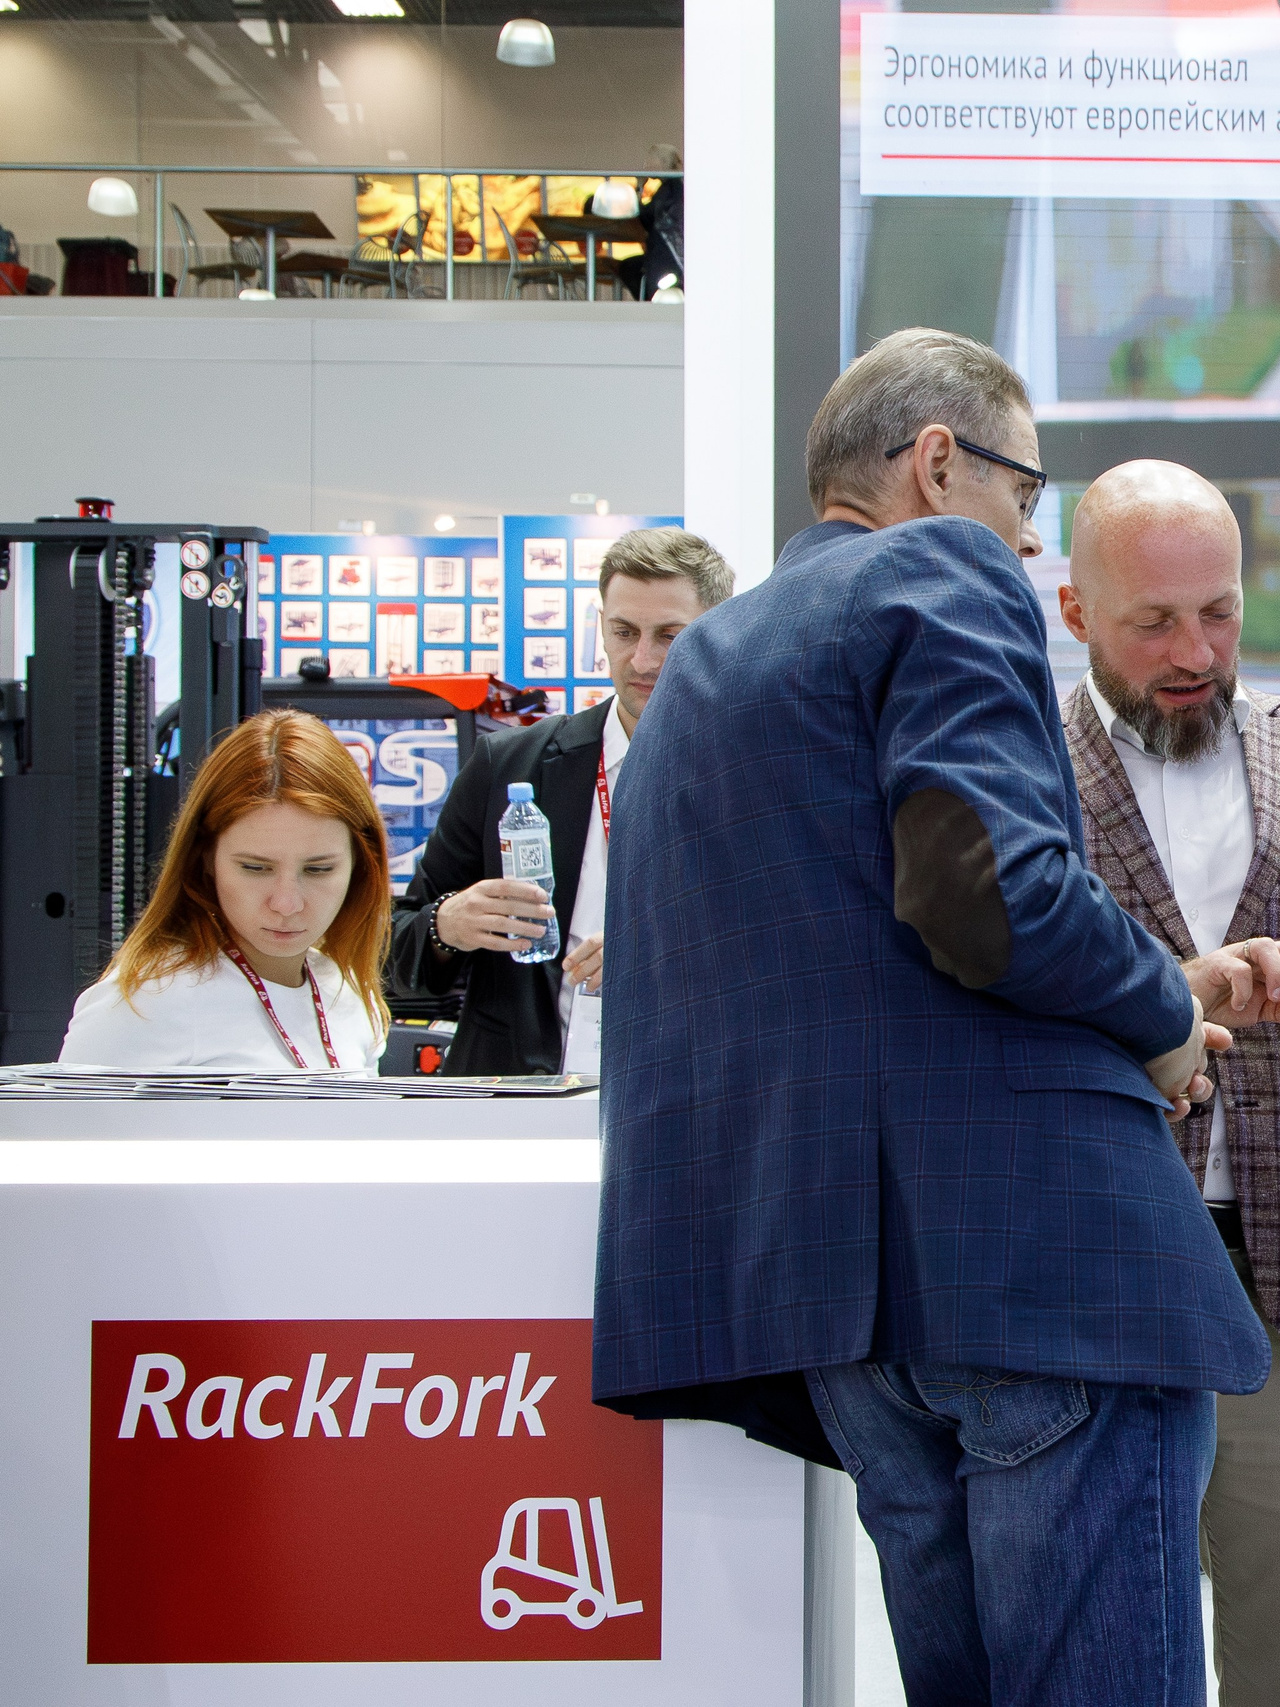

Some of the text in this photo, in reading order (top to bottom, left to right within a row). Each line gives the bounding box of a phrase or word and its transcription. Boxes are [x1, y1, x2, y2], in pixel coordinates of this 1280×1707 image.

[884, 46, 1250, 87] Эргономика и функционал
[884, 102, 1078, 137] соответствуют
[1086, 99, 1266, 138] европейским
[117, 1352, 558, 1440] RackFork
